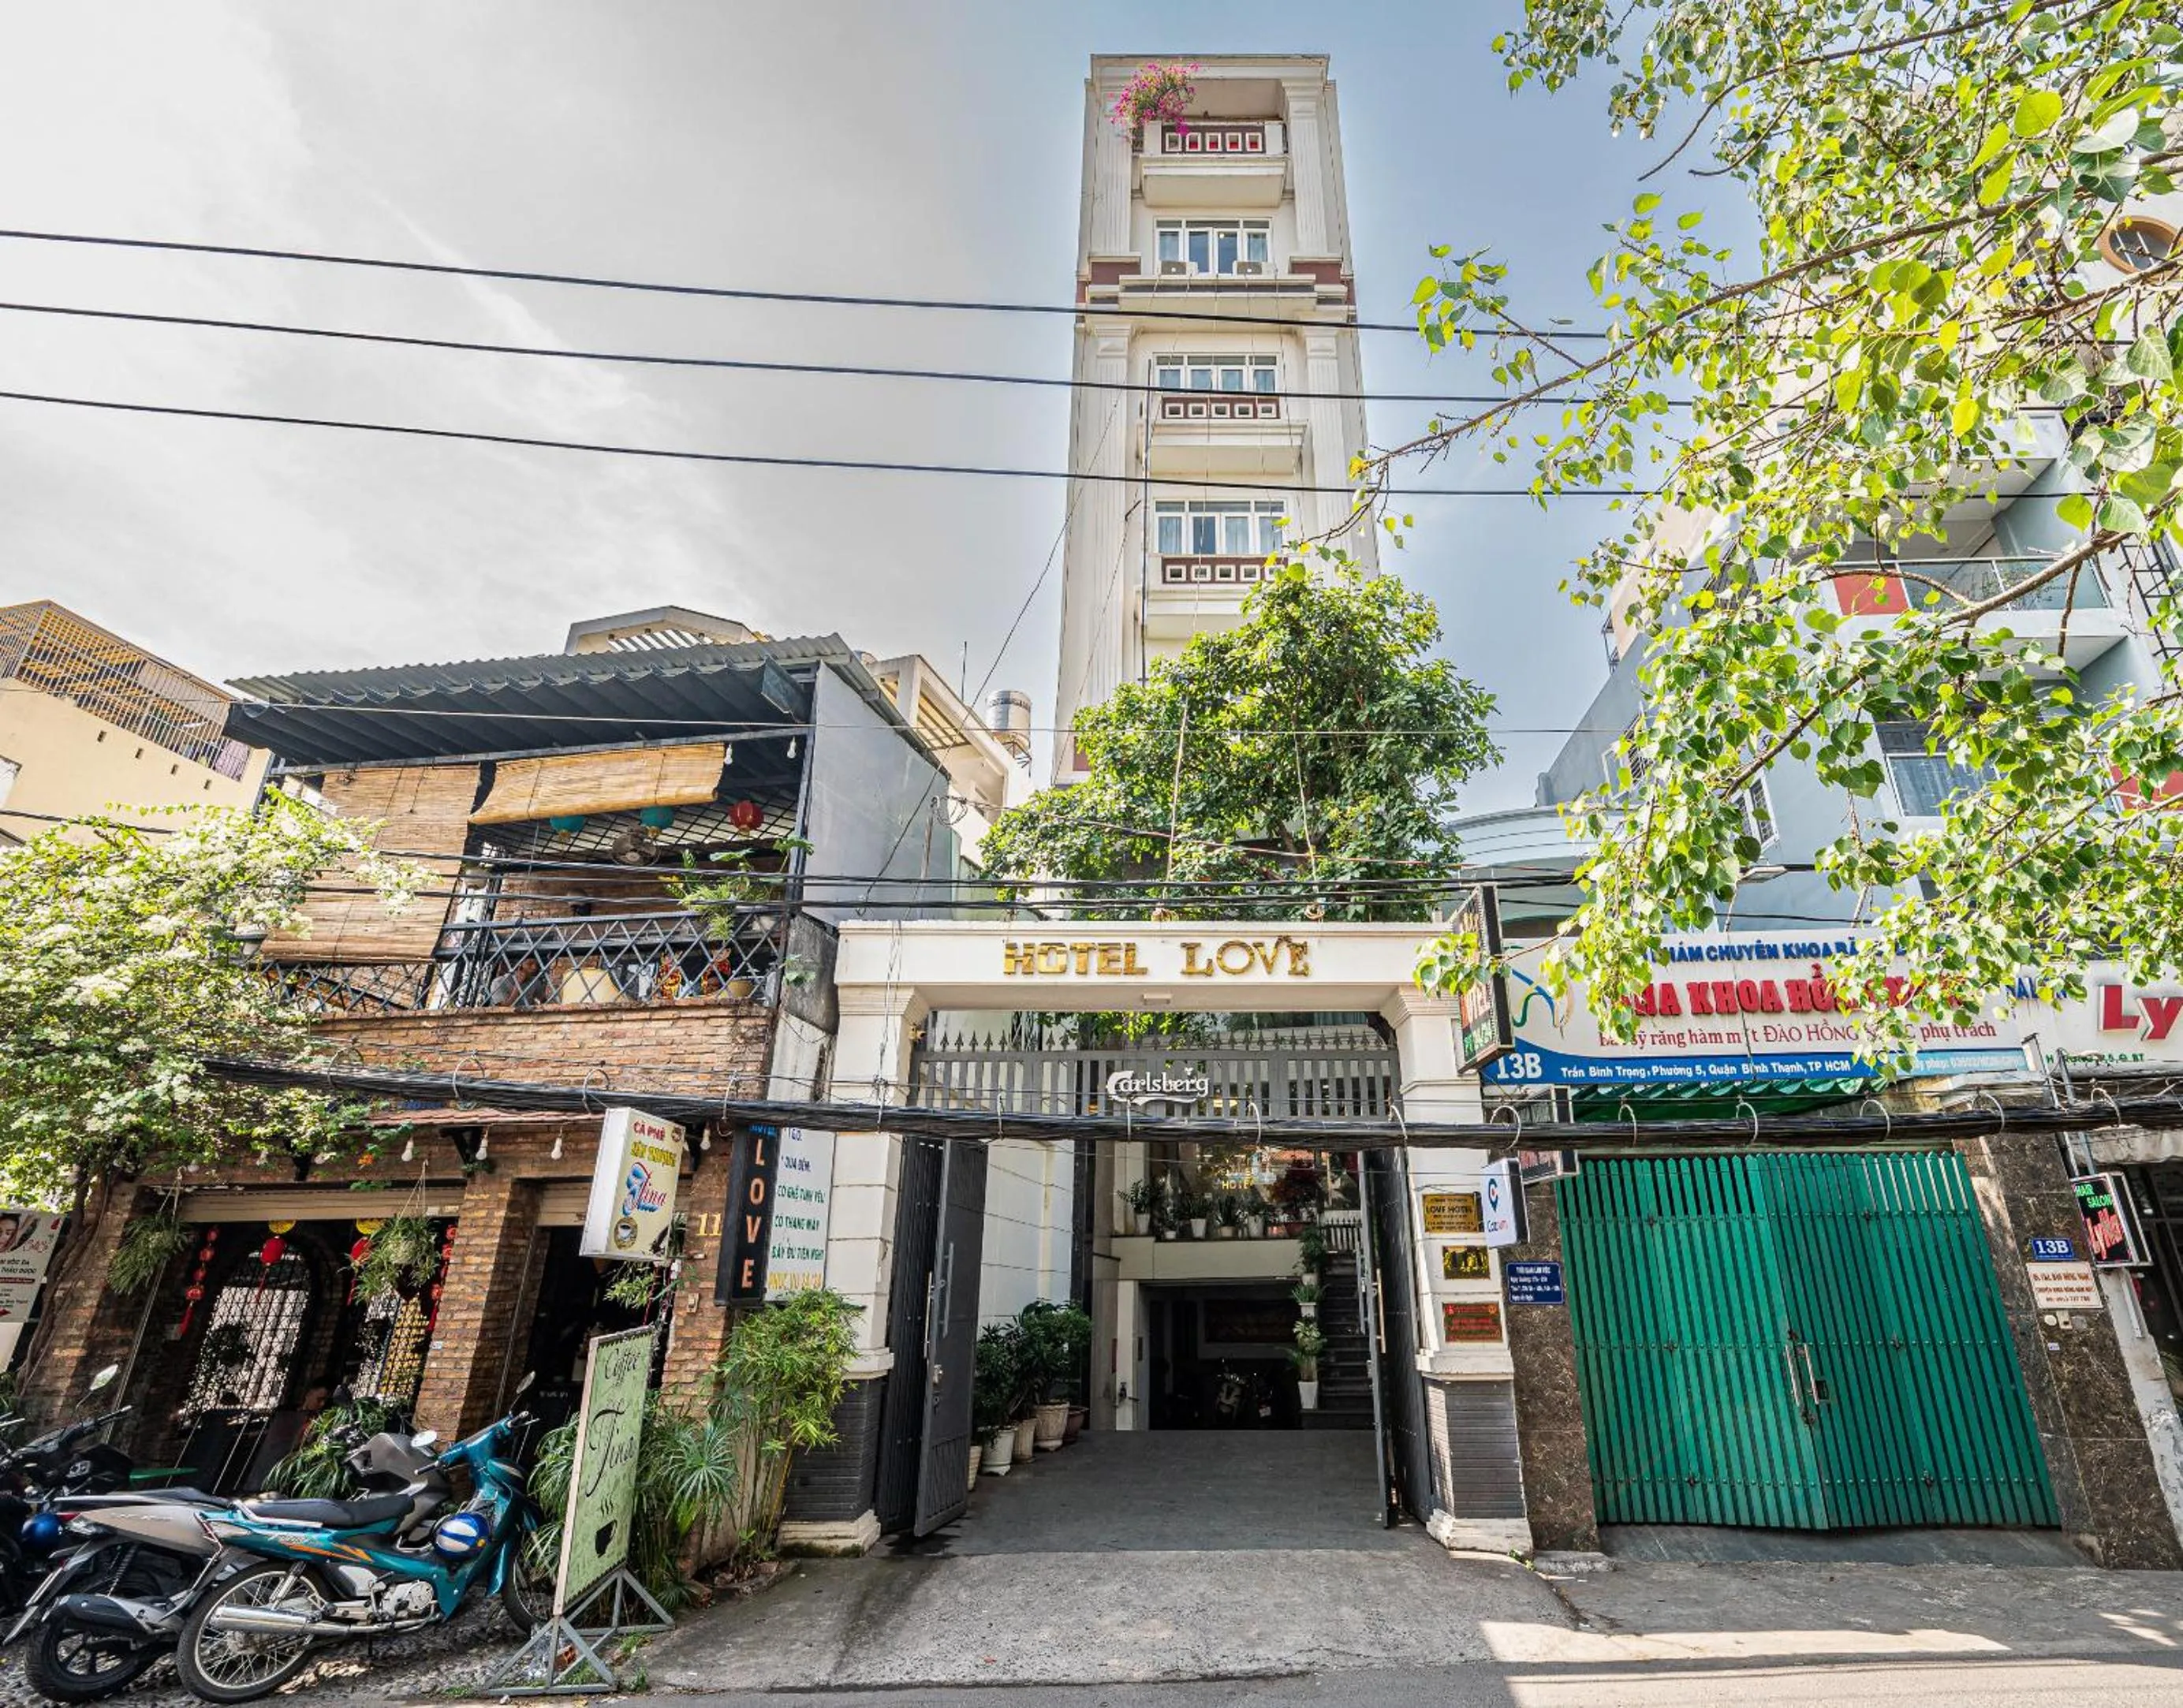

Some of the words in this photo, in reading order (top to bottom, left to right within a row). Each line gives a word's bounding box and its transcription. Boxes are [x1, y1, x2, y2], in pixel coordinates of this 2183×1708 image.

[1003, 942, 1148, 975] HOTEL
[1181, 935, 1311, 977] LOVE
[1706, 939, 1780, 961] CHUYÊN
[1782, 942, 1833, 960] KHOA
[1686, 979, 1785, 1015] KHOA
[1651, 1029, 1686, 1048] răng
[1688, 1028, 1722, 1045] hàm
[1727, 1028, 1759, 1044] mt
[1763, 1023, 1803, 1042] ĐÀO
[1806, 1018, 1860, 1042] HỒNG
[1920, 1022, 1952, 1042] phụ
[1953, 1022, 1998, 1038] trách
[1497, 1052, 1542, 1079] 13B
[1560, 1065, 1585, 1078] Trần
[1588, 1065, 1614, 1078] Bình
[1708, 1064, 1737, 1077] Quận
[1807, 1061, 1823, 1072] TP
[1824, 1060, 1851, 1072] HCM
[1106, 1068, 1210, 1104] Carlsberg
[2074, 1183, 2095, 1197] HAIR
[2086, 1194, 2113, 1209] SALON
[696, 1213, 722, 1236] 11
[741, 1138, 765, 1289] LOVE
[2036, 1240, 2069, 1254] 13B
